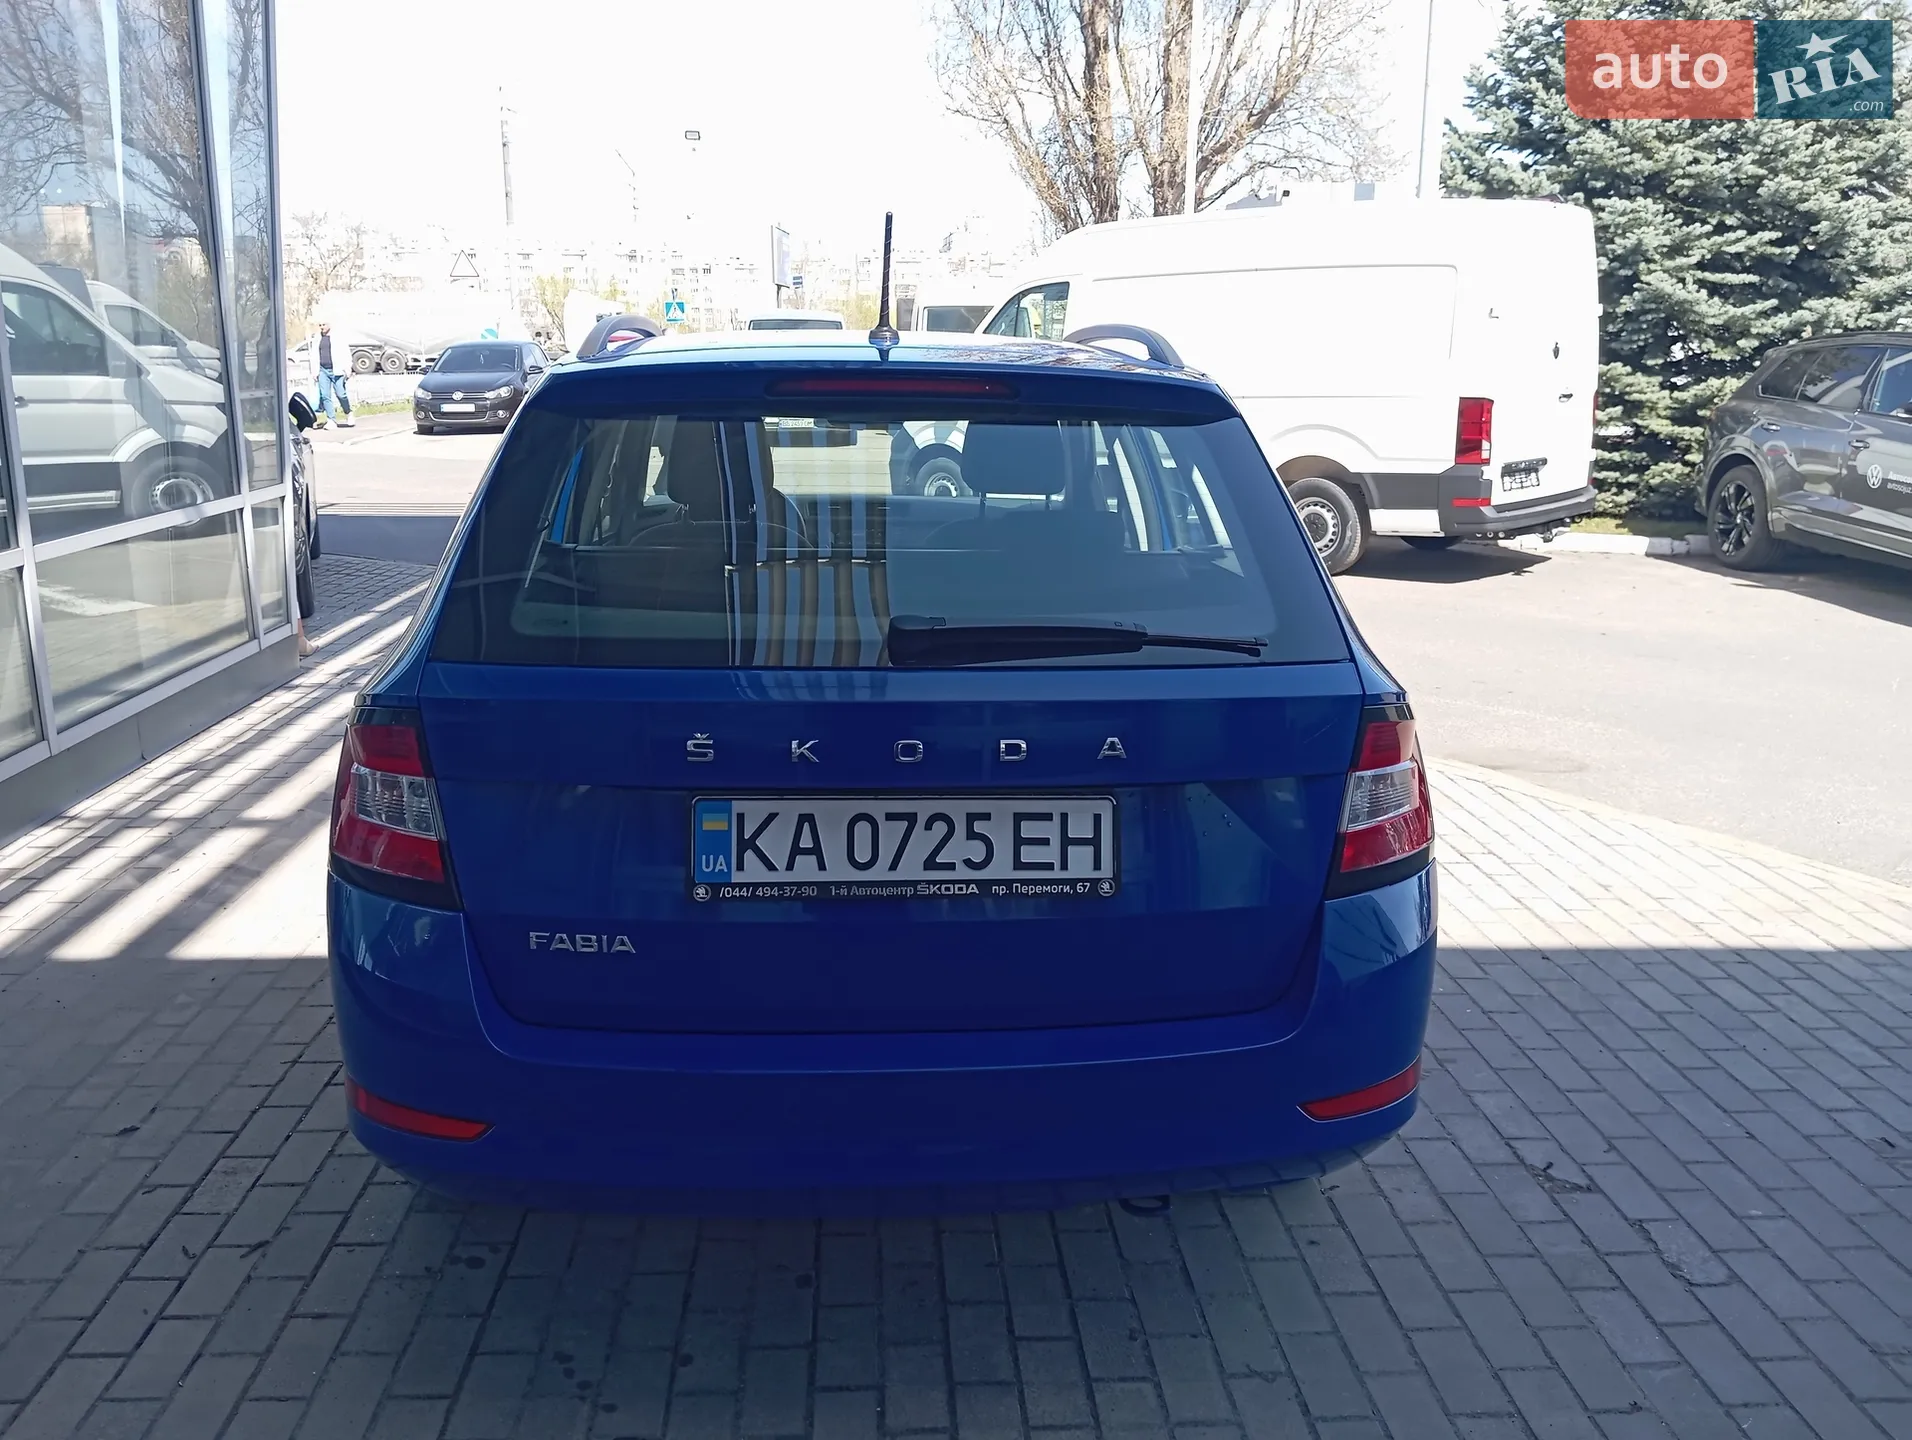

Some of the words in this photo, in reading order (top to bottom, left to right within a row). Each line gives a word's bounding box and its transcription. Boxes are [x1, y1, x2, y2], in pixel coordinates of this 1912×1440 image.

[686, 733, 1127, 763] ŠKODA
[735, 812, 827, 872] KA
[846, 812, 995, 872] 0725
[1013, 812, 1101, 872] EH
[702, 855, 728, 873] UA
[719, 886, 753, 898] /044/
[755, 886, 817, 897] 494-37-90
[829, 885, 848, 896] 1-й
[850, 884, 914, 898] Автоцентр
[916, 882, 979, 895] ŠKODA
[991, 884, 1009, 897] пр.
[1012, 883, 1073, 896] Перемоги,
[1076, 882, 1091, 893] 67
[529, 931, 636, 954] FABIA
